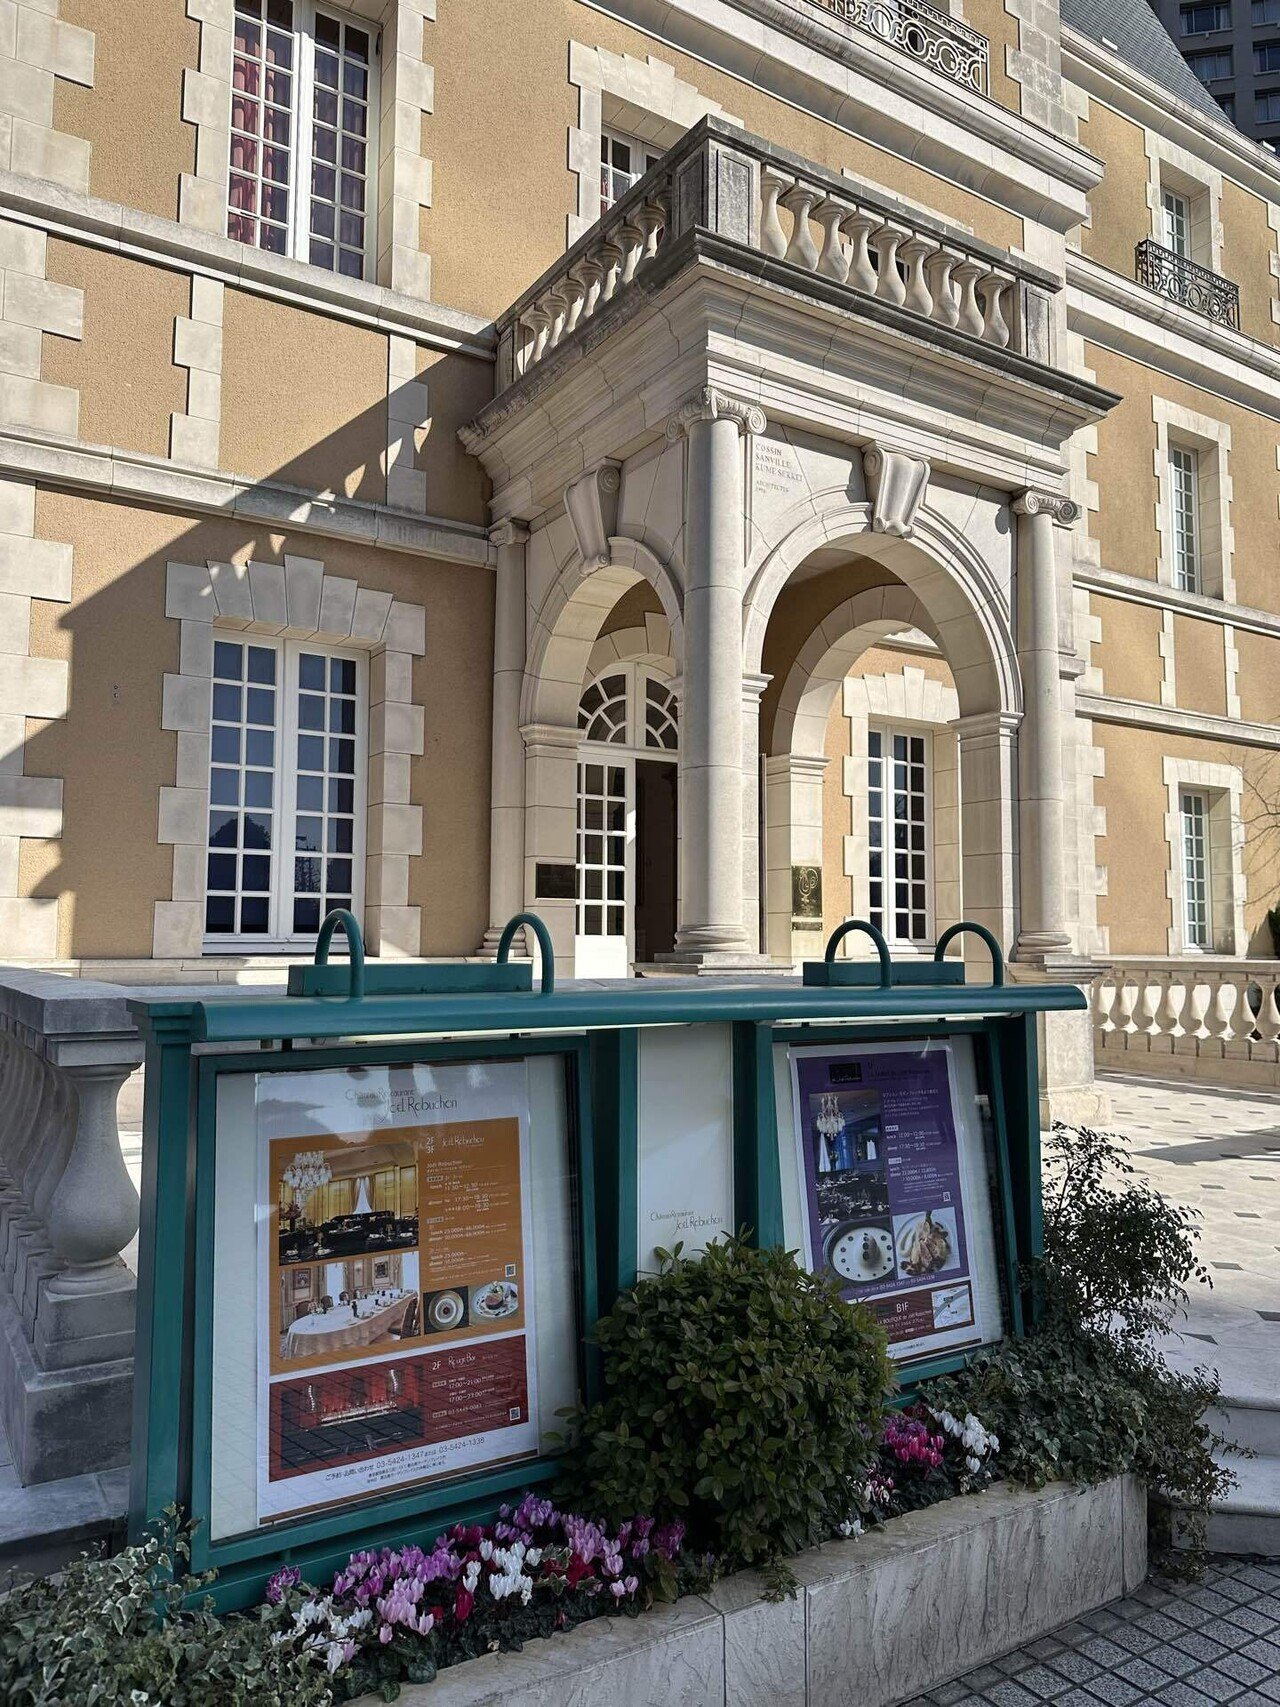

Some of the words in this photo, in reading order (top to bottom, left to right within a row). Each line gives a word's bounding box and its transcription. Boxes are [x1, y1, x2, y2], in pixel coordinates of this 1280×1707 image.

[755, 442, 783, 456] COSSIN
[755, 453, 791, 468] SANVILLE
[407, 1094, 458, 1117] Robuchon
[426, 1136, 435, 1145] 2F
[896, 1301, 909, 1313] B1F
[432, 1360, 441, 1371] 2F
